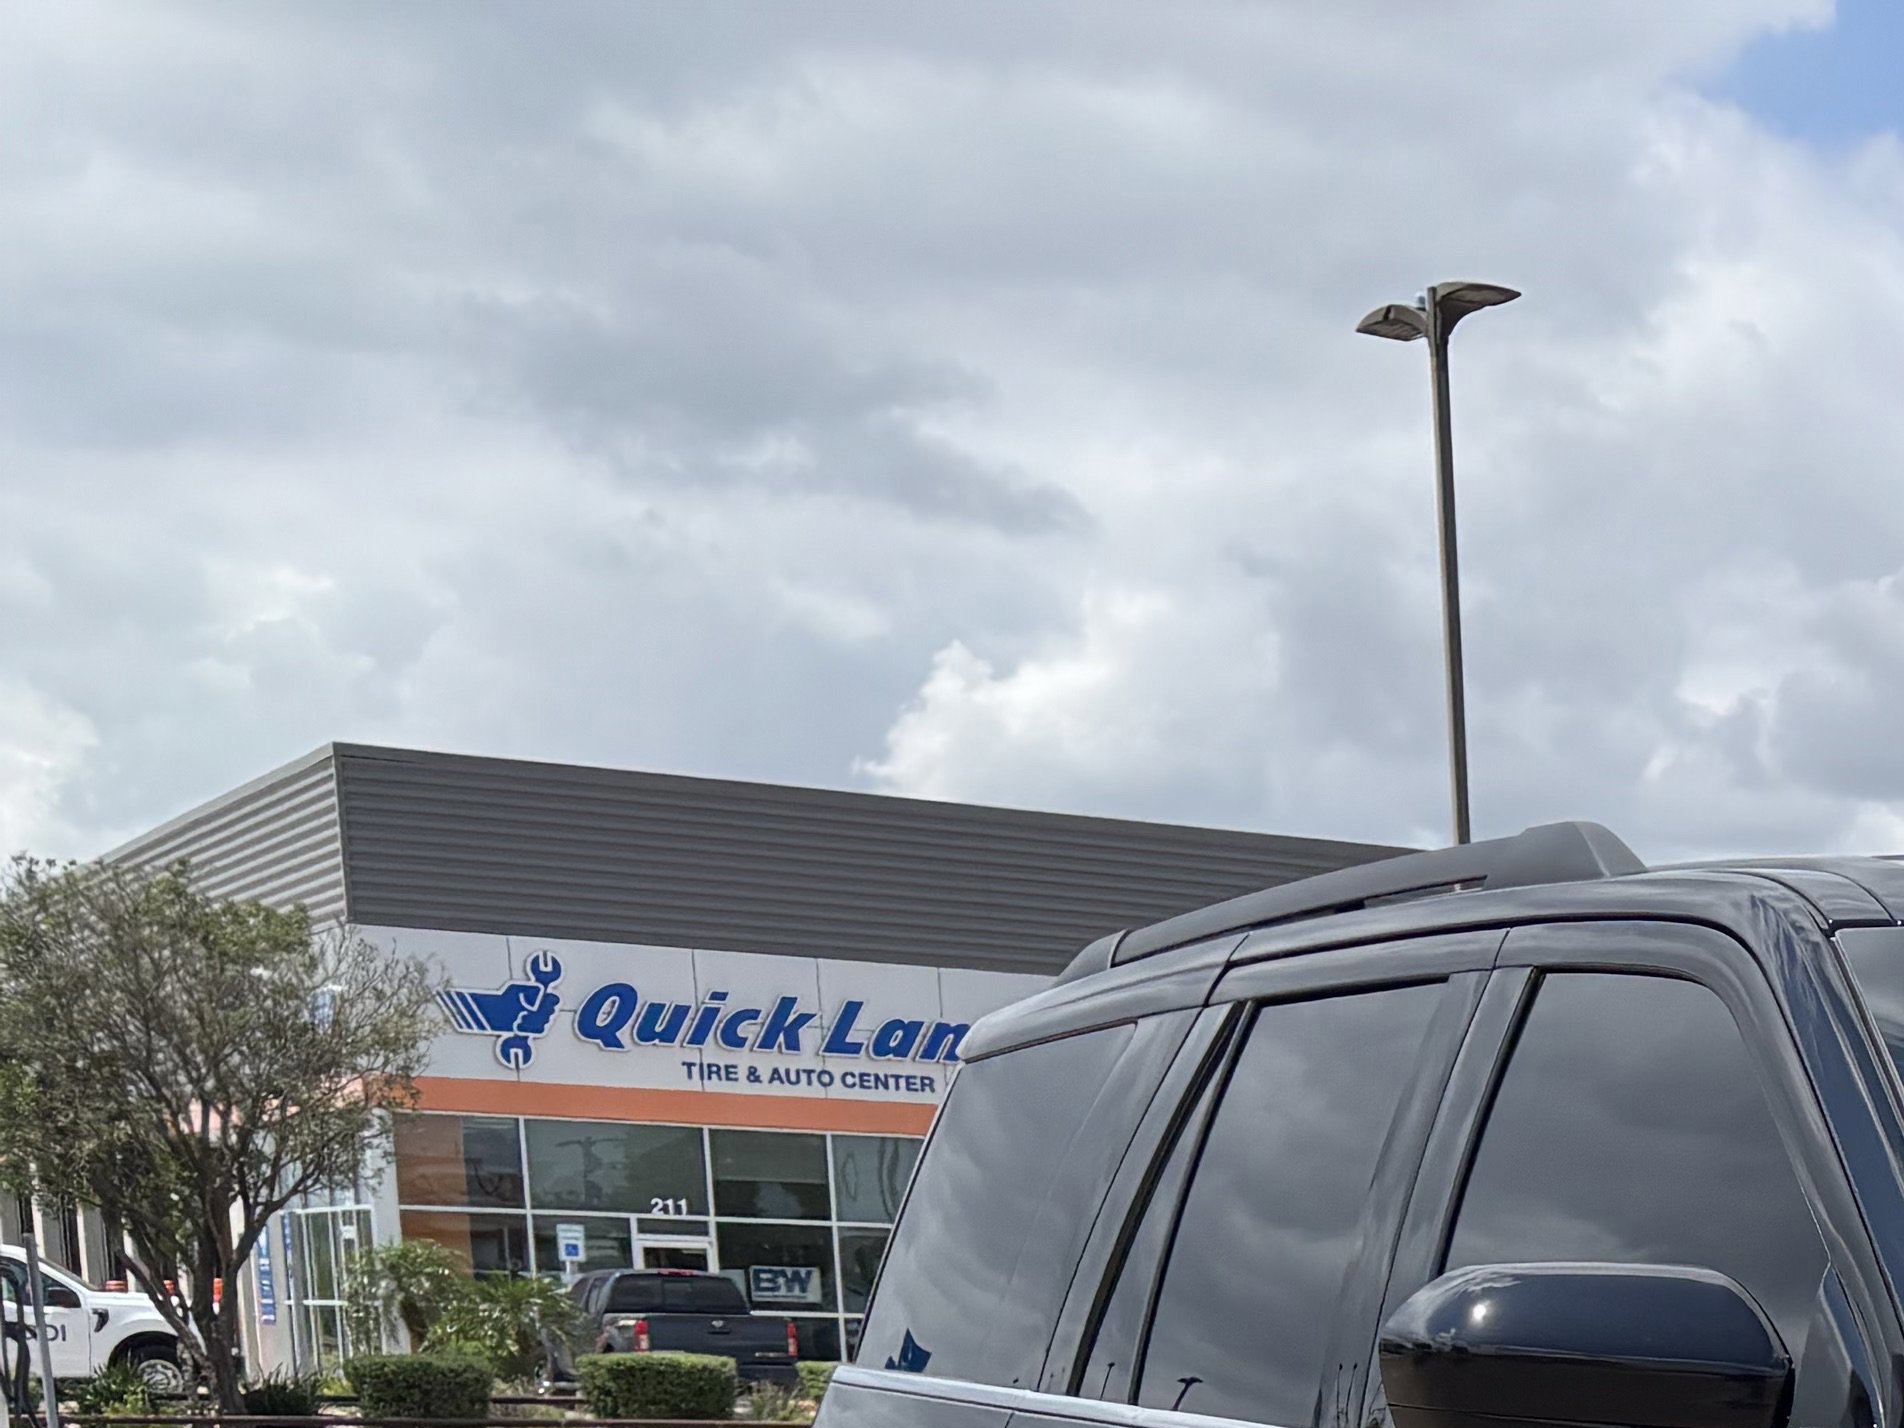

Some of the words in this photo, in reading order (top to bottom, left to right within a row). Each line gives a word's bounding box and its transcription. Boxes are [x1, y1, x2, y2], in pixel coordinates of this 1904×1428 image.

[576, 982, 818, 1052] Quick
[822, 1000, 968, 1063] Lan
[681, 1061, 740, 1083] TIRE
[745, 1067, 763, 1084] &
[769, 1067, 835, 1088] AUTO
[841, 1071, 936, 1093] CENTER
[650, 1197, 688, 1216] 211
